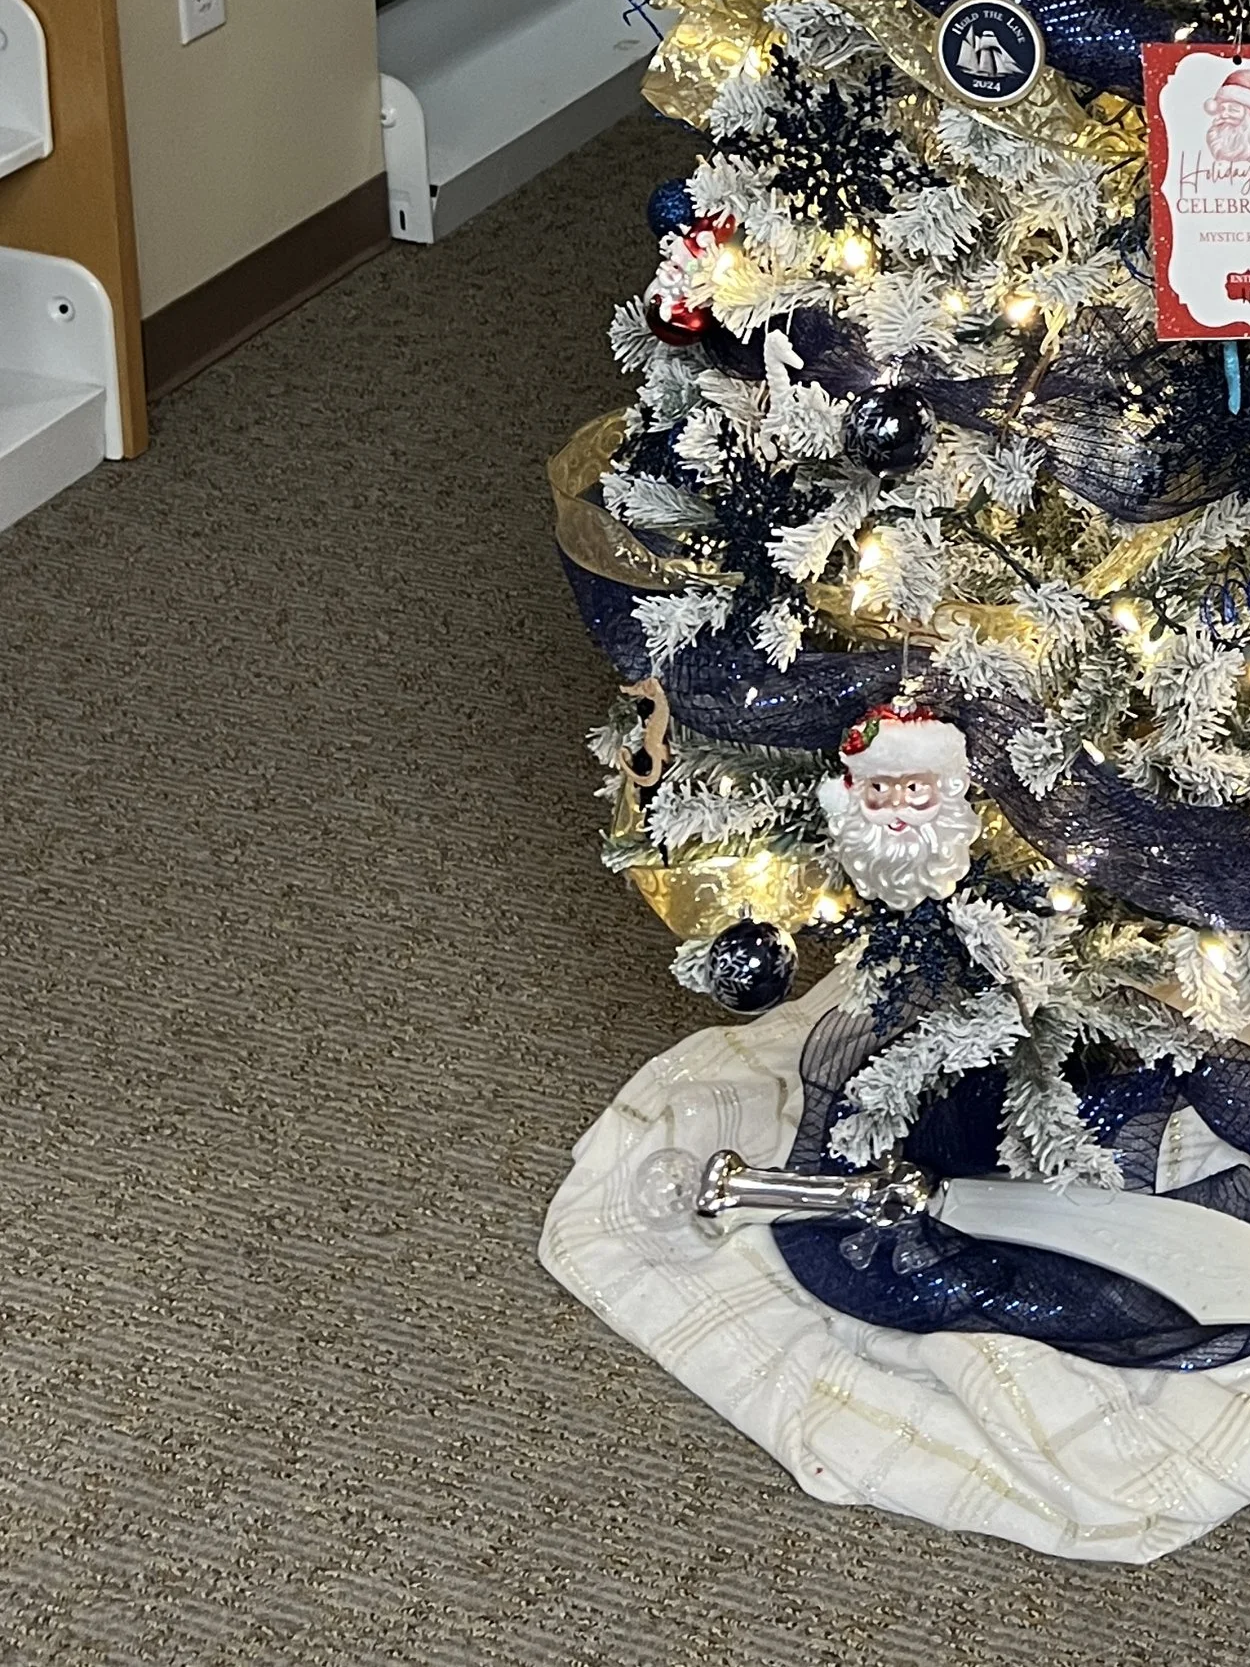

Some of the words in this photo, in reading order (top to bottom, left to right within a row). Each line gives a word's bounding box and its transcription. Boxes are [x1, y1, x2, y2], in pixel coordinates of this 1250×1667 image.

[952, 12, 979, 35] HOLD
[983, 10, 1003, 21] THE
[1006, 17, 1026, 43] LINE
[973, 79, 1001, 92] 2024
[1199, 232, 1244, 242] MYSTIC
